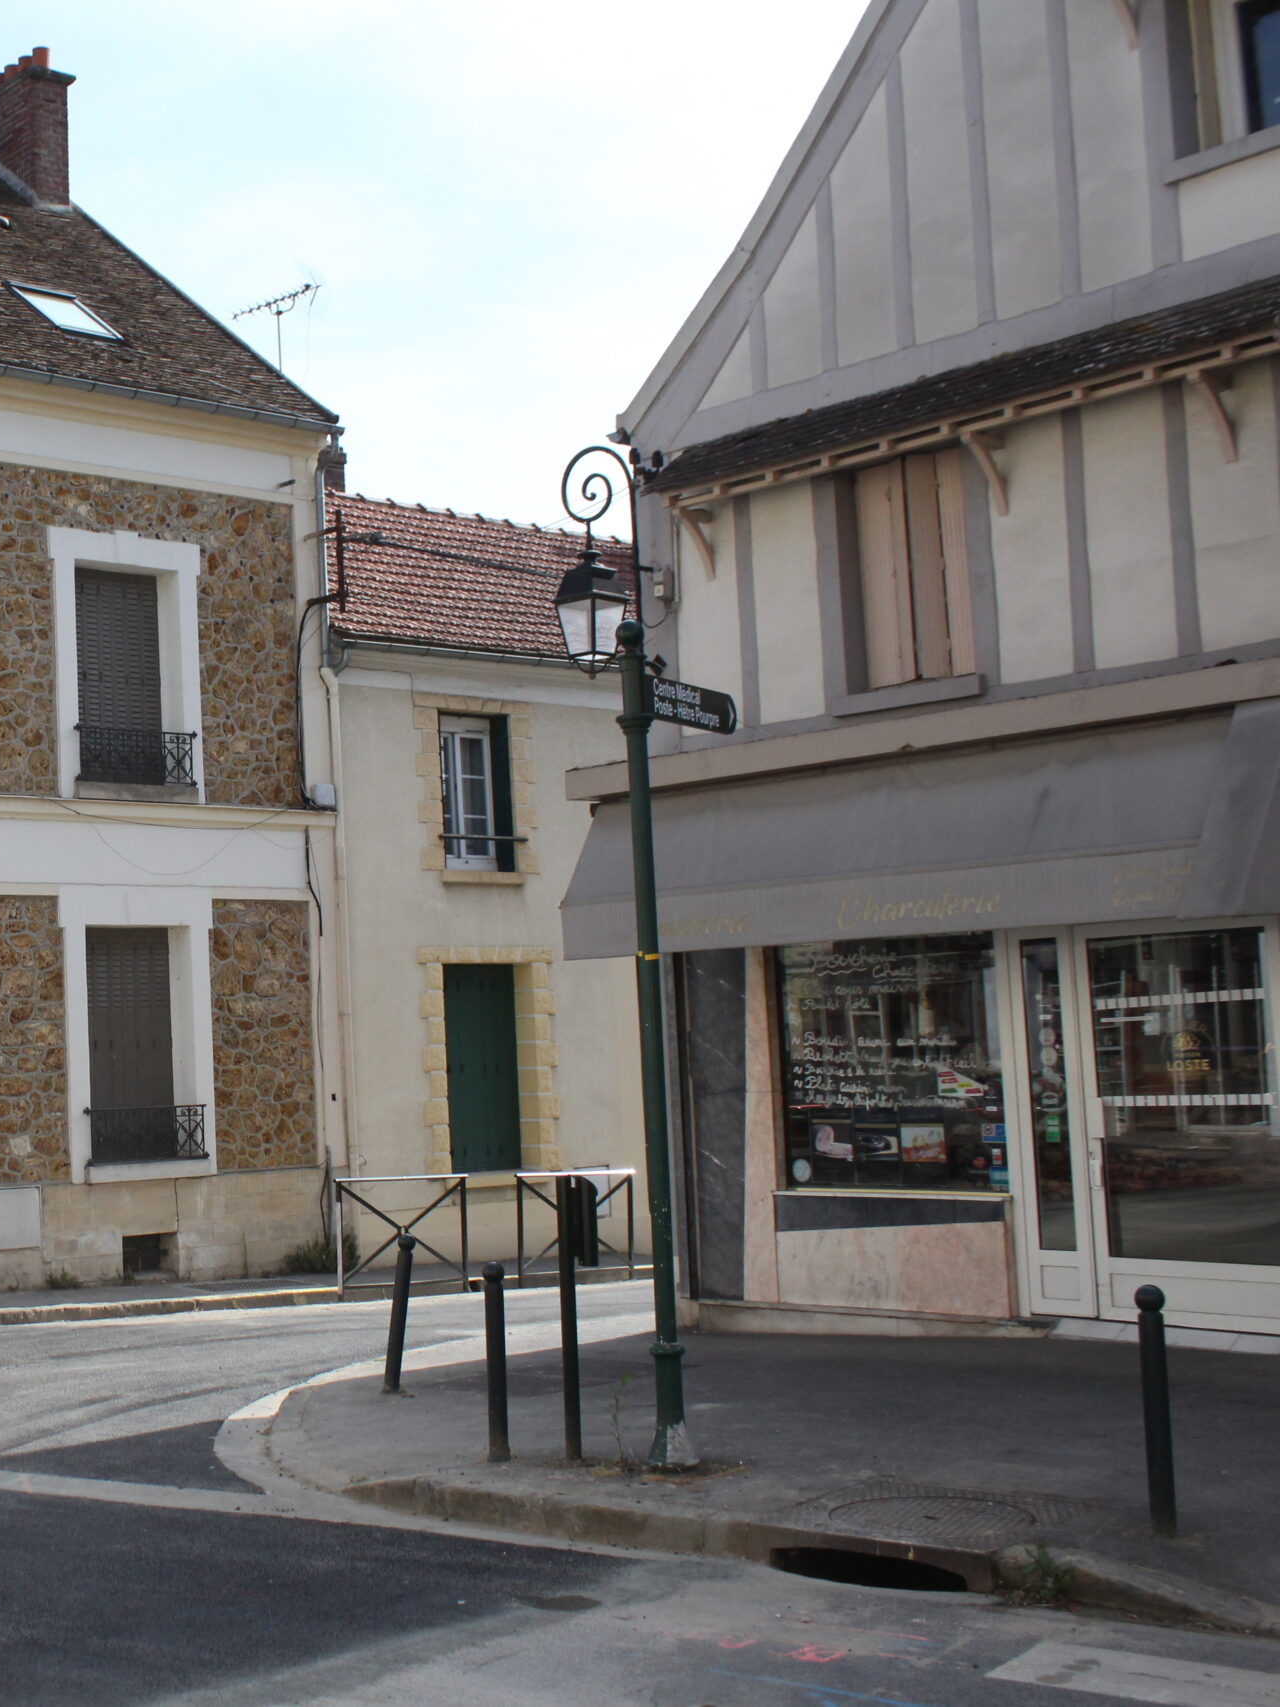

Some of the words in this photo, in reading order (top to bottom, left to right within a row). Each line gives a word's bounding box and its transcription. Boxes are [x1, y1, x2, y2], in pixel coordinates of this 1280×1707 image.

[653, 678, 675, 699] Centre
[676, 684, 701, 705] Médical
[653, 697, 673, 716] Poste
[677, 702, 695, 722] Hêtre
[695, 707, 720, 728] Pourpre
[836, 888, 1002, 932] Charcuterie
[1166, 1059, 1211, 1072] LOSTE
